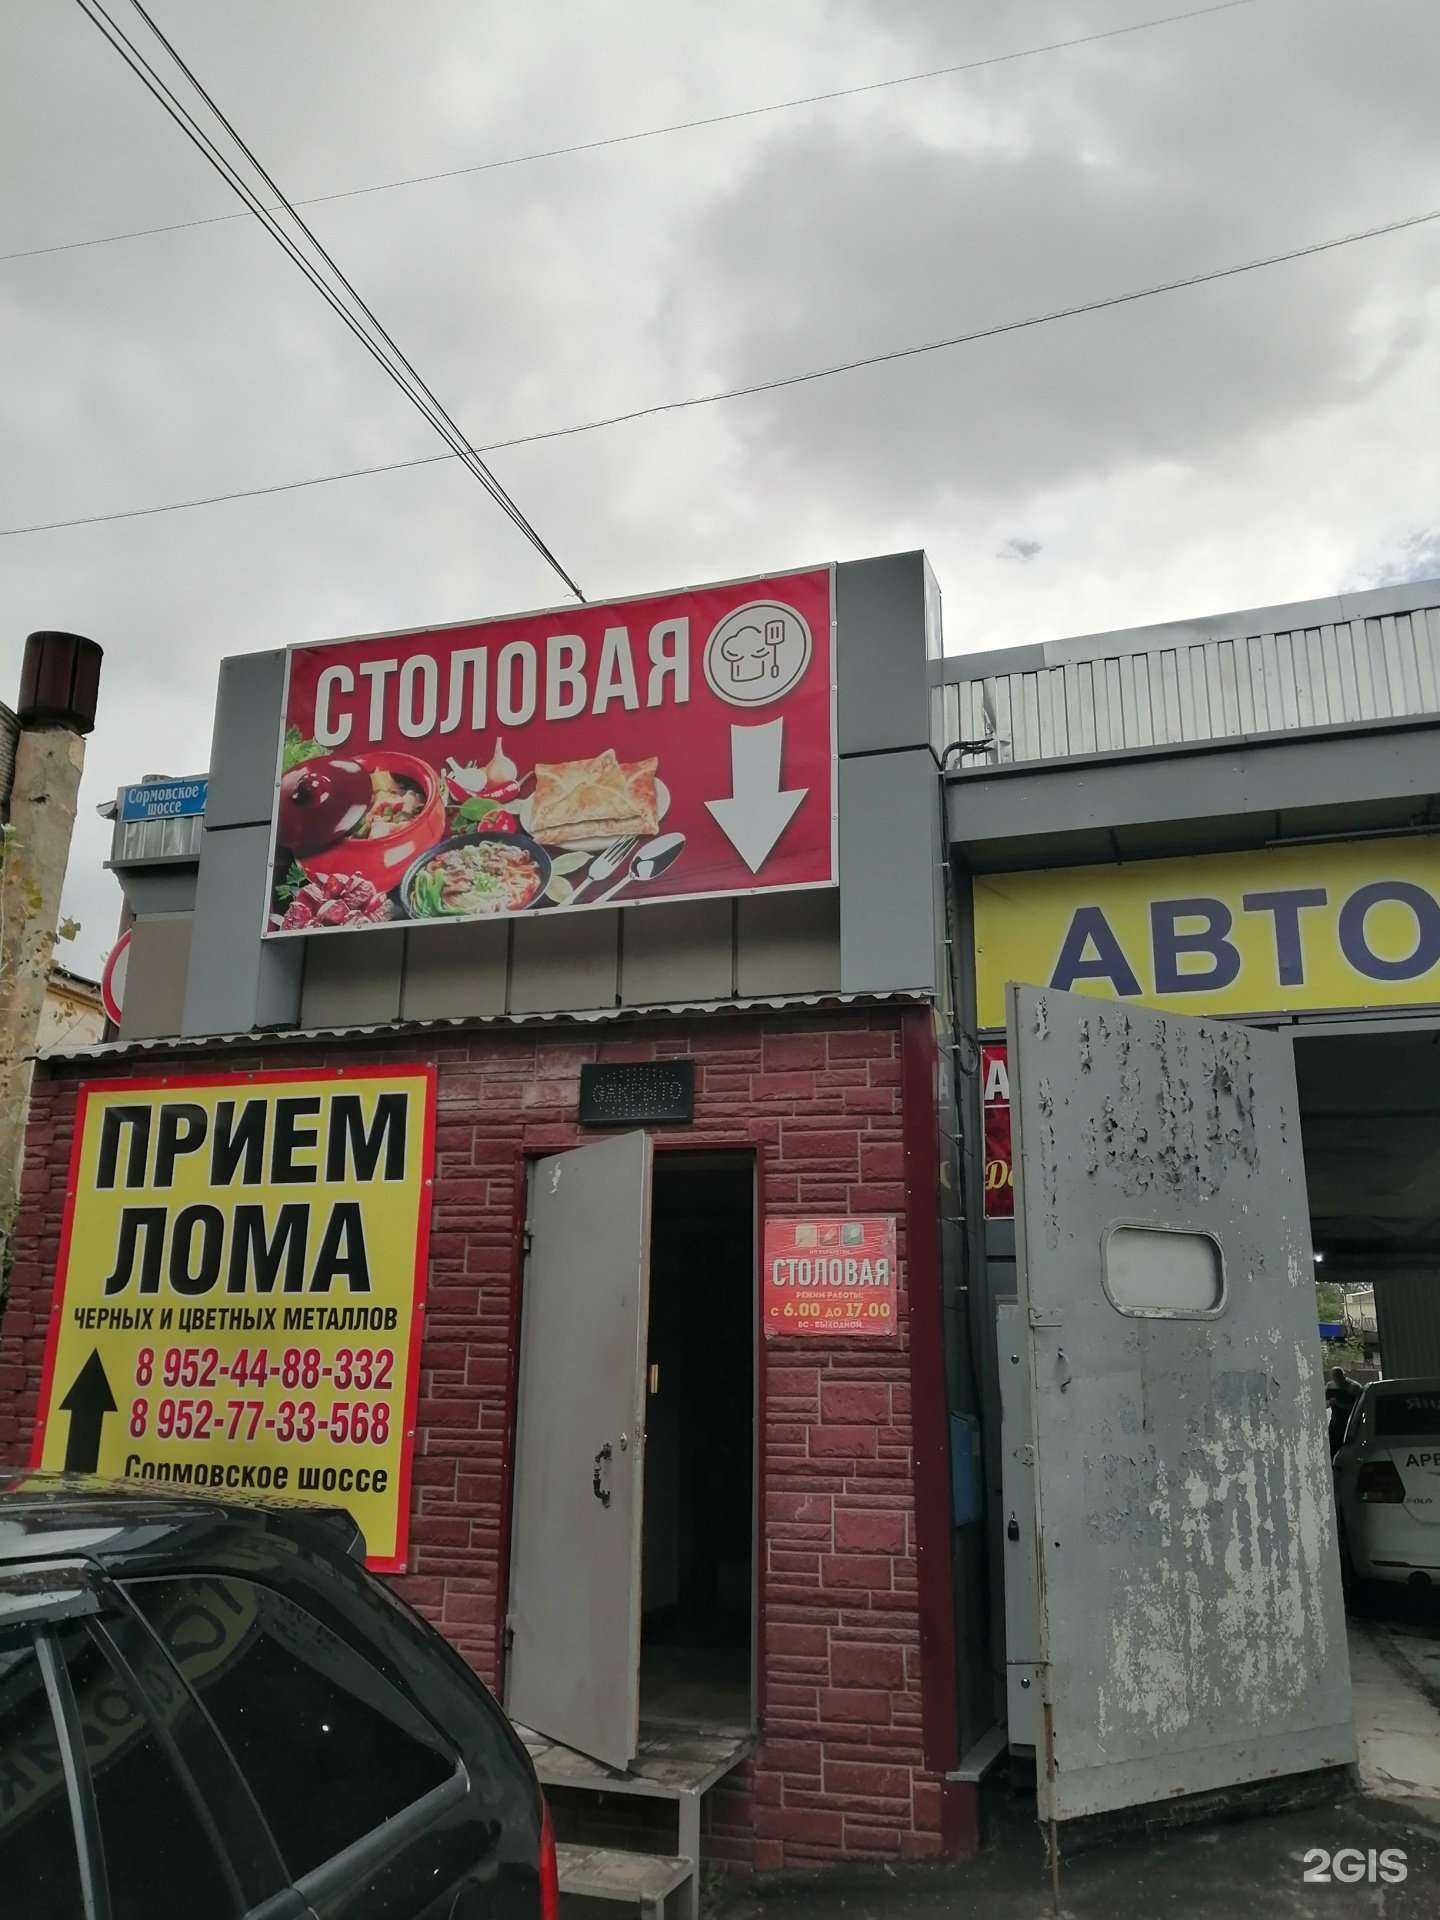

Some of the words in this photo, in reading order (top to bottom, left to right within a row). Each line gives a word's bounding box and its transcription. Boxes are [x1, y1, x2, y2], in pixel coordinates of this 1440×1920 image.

[313, 616, 690, 748] СТОЛОВАЯ
[128, 784, 199, 806] Сормовское
[147, 801, 182, 815] шоссе
[1049, 880, 1440, 997] АВТО
[96, 1093, 408, 1189] ПРИЕМ
[104, 1202, 371, 1296] ЛОМА
[772, 1258, 889, 1286] СТОЛОВАЯ
[74, 1307, 153, 1330] ЧЕРНЫХ
[159, 1307, 173, 1330] И
[178, 1307, 276, 1333] ЦВЕТНЫХ
[283, 1306, 398, 1331] МЕТАЛЛОВ
[783, 1302, 820, 1317] 6.00
[846, 1302, 890, 1318] 17.00
[135, 1347, 154, 1387] 8
[163, 1347, 394, 1390] 952-44-88-332
[129, 1398, 148, 1438] 8
[157, 1398, 390, 1445] 952-77-33-568
[298, 1466, 388, 1493] шоссе
